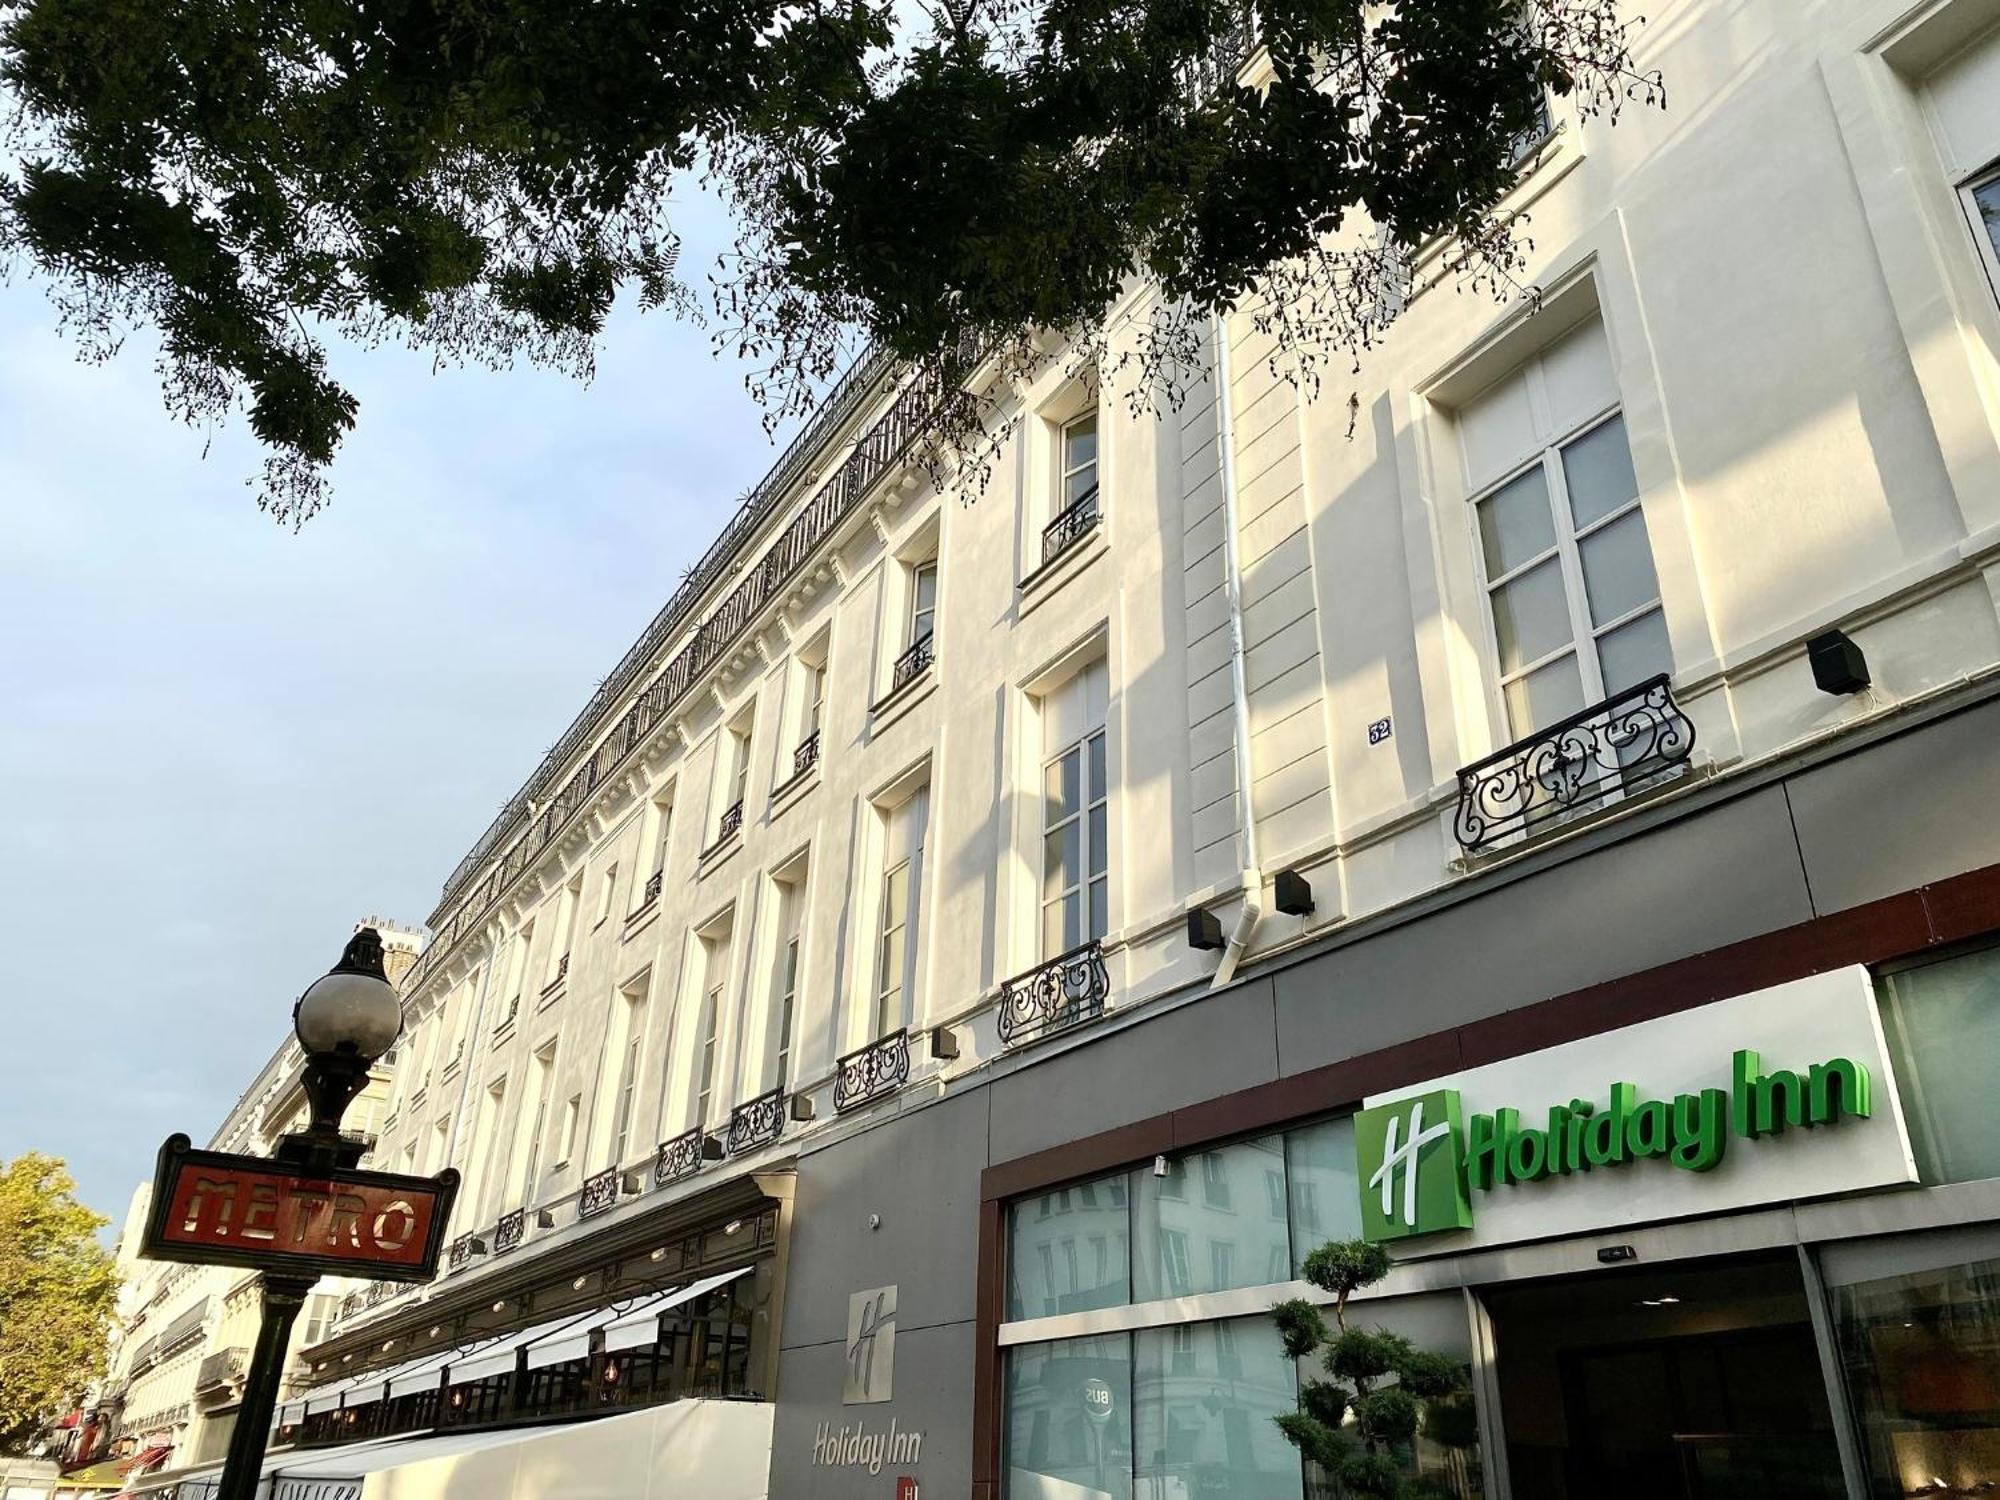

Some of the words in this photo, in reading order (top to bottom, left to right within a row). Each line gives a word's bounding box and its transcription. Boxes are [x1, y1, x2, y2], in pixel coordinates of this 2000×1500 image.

[1463, 1082, 1727, 1188] Holiday
[1733, 1048, 1872, 1140] Inn
[183, 1179, 415, 1250] METRO
[812, 1421, 885, 1475] Holiday
[887, 1417, 921, 1463] Inn
